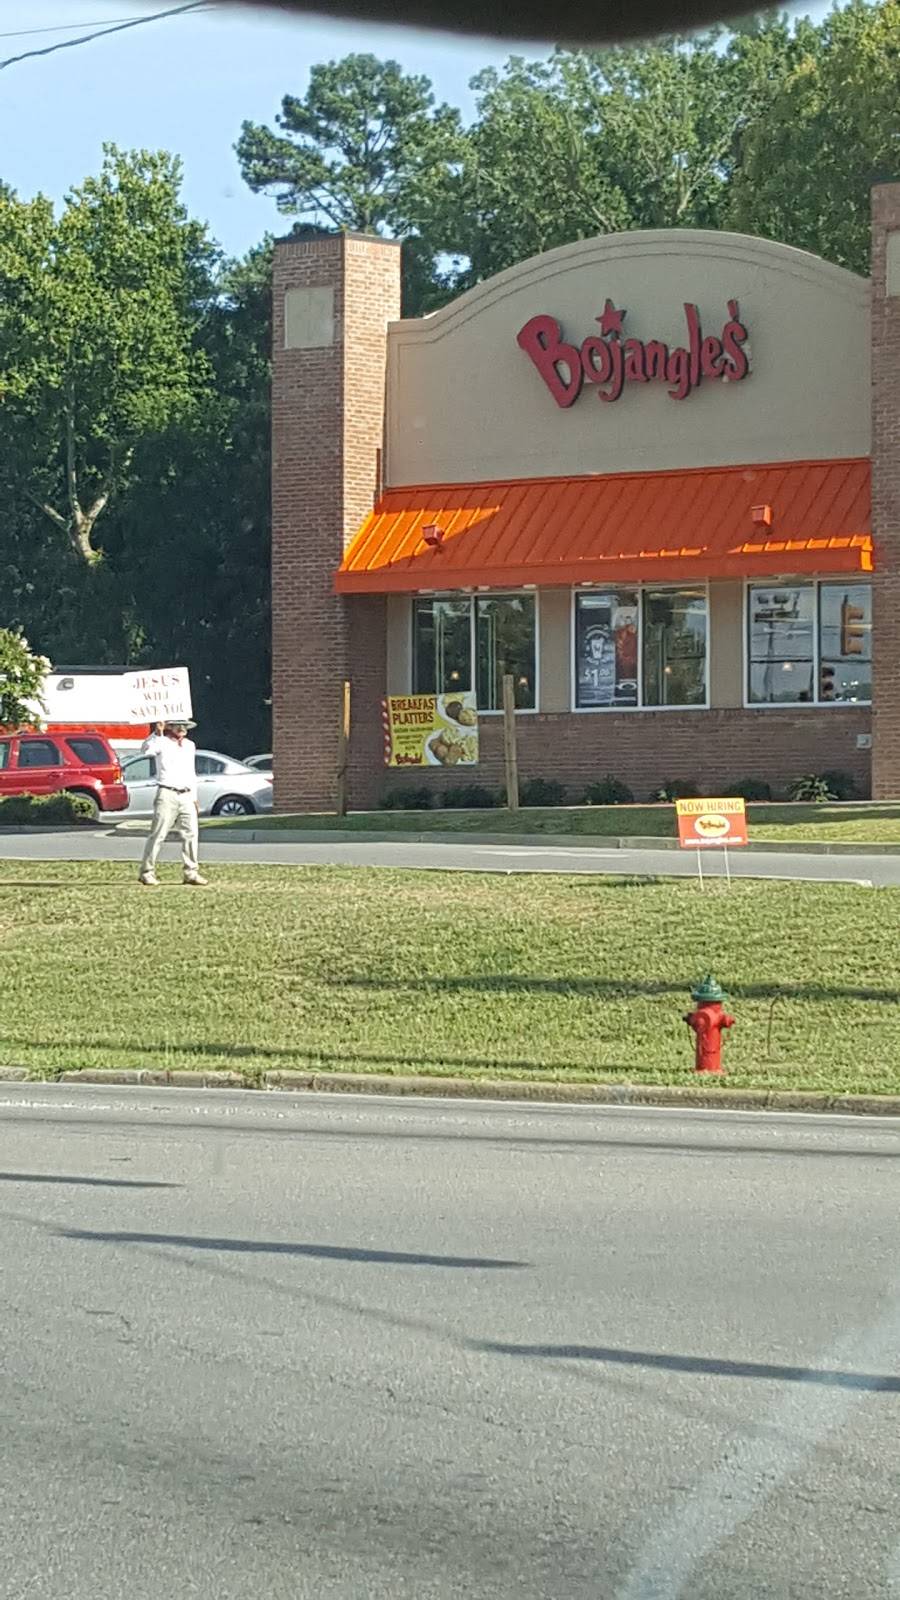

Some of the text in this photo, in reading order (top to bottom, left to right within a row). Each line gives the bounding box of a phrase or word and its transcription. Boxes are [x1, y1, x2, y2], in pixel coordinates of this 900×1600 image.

[133, 674, 181, 689] JESUS
[392, 711, 434, 725] PLATTERS
[680, 801, 742, 813] NOW HIRING
